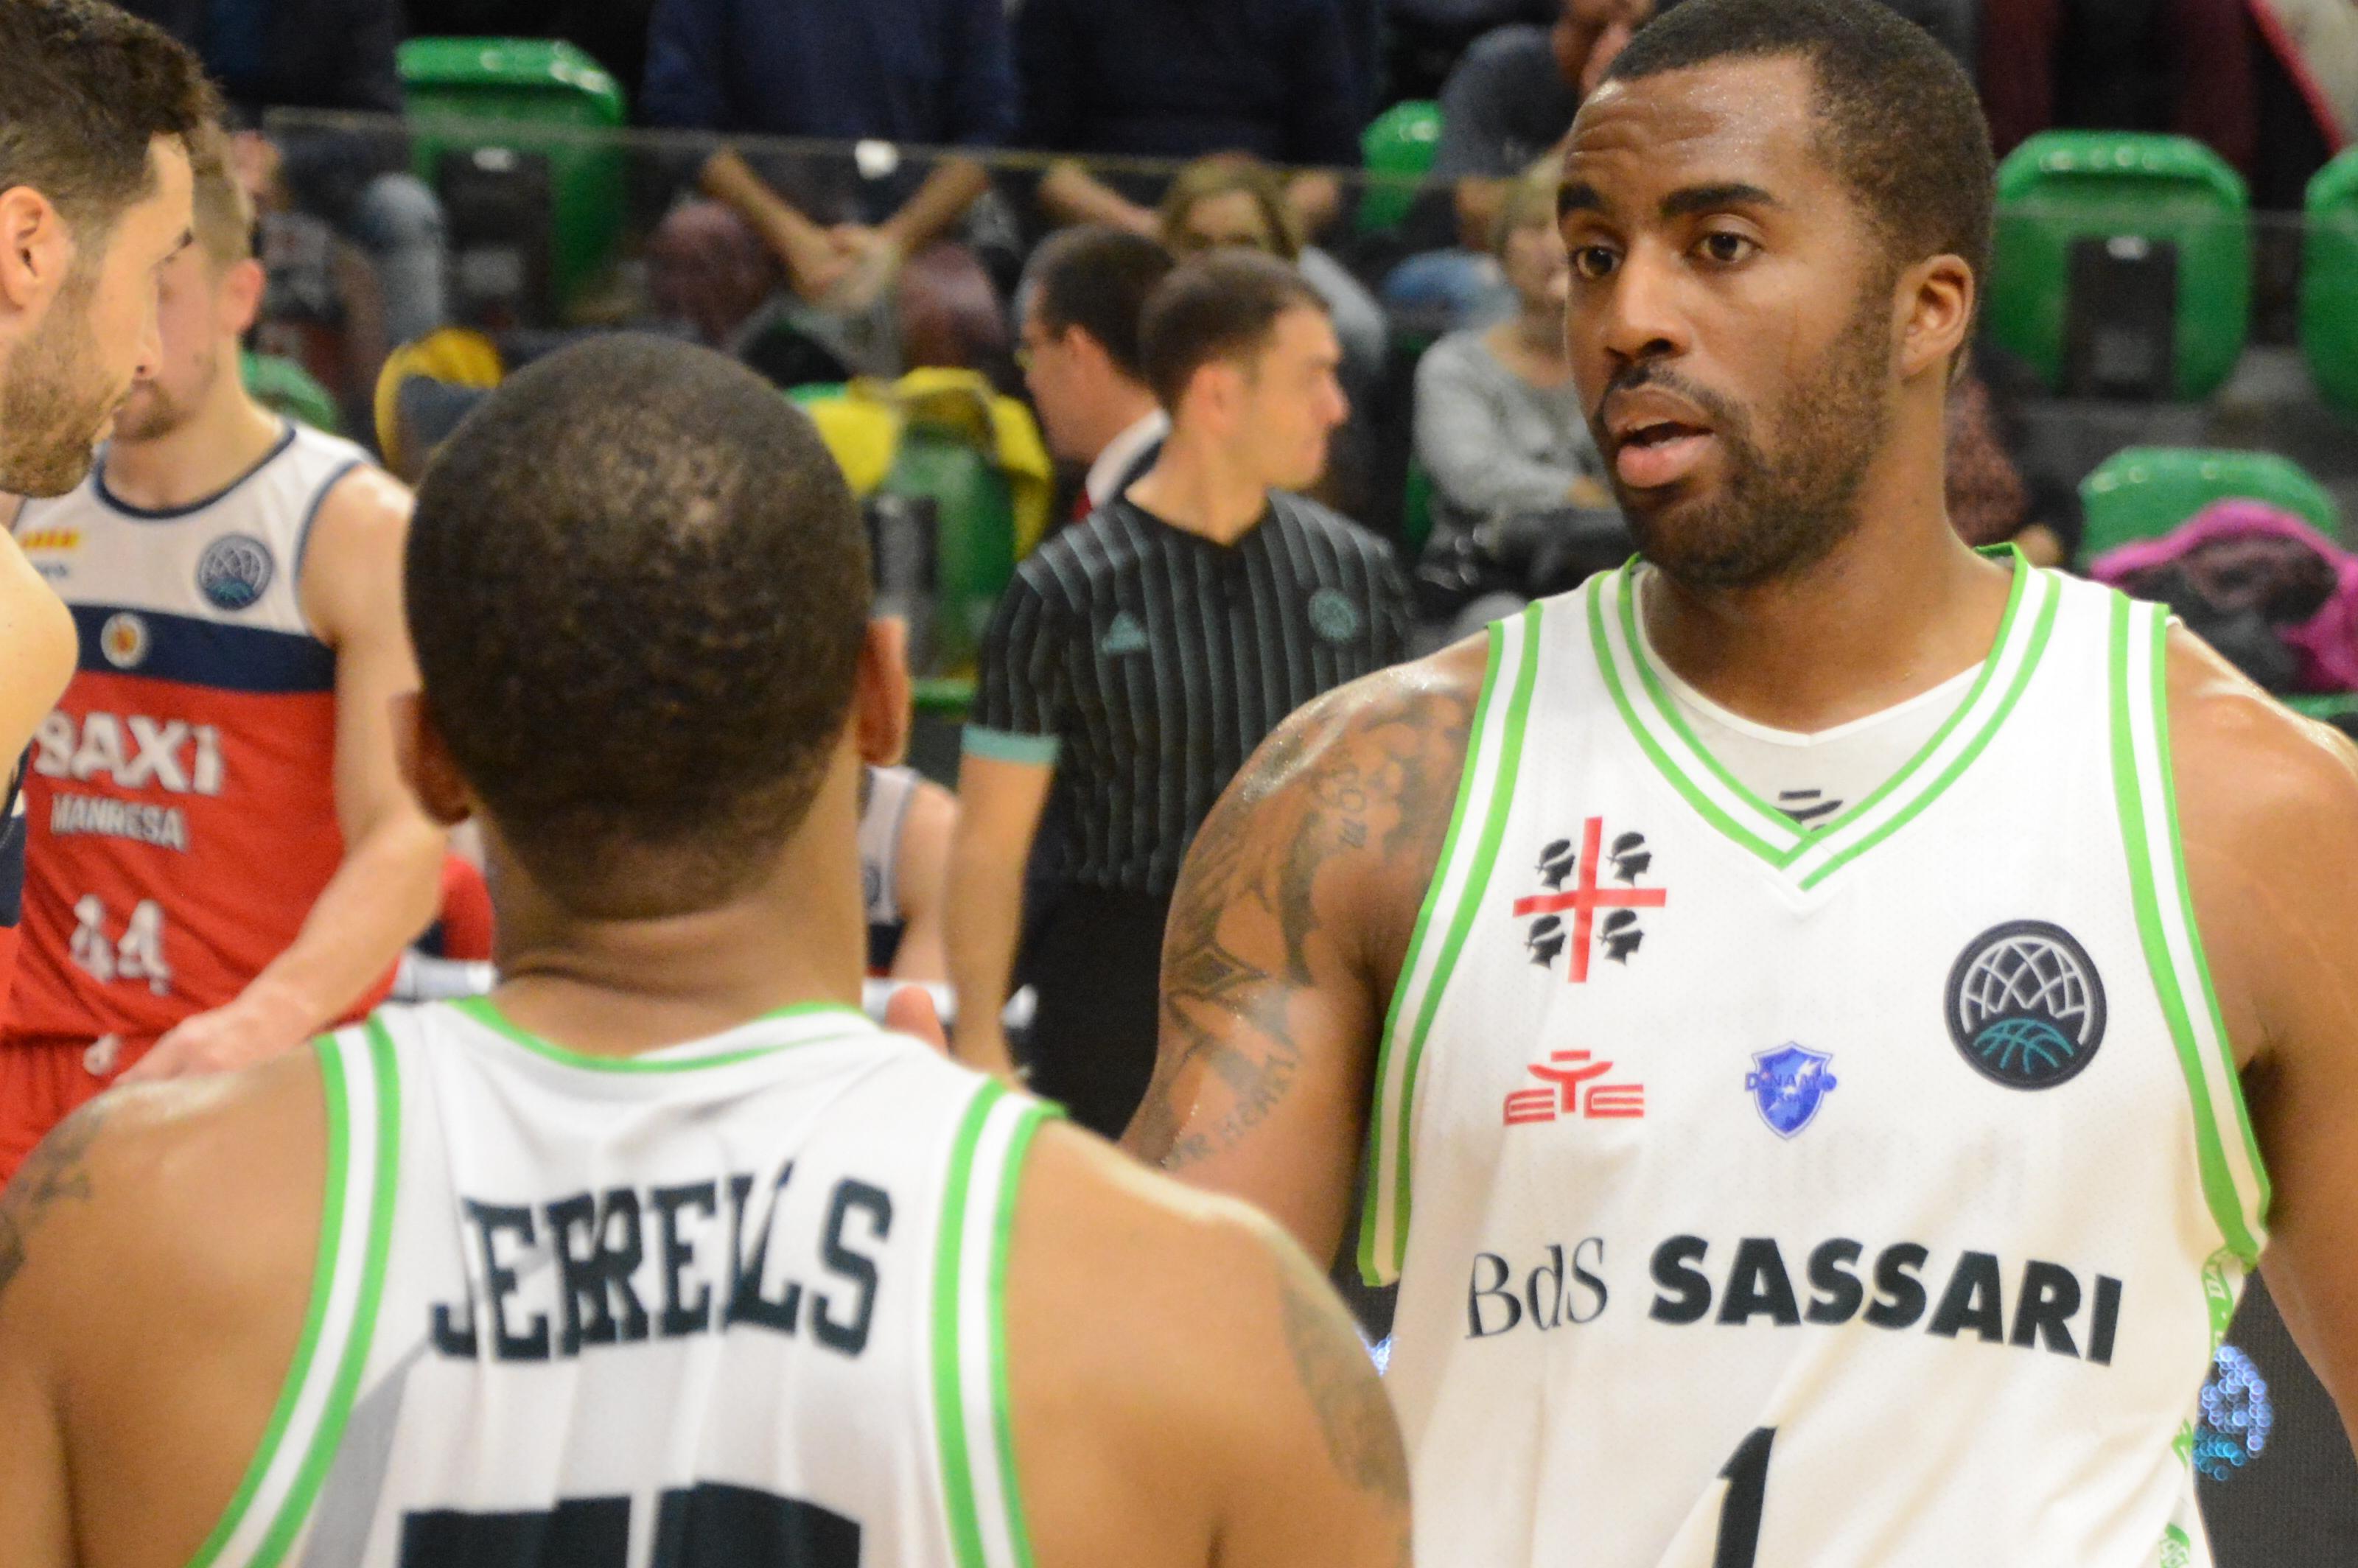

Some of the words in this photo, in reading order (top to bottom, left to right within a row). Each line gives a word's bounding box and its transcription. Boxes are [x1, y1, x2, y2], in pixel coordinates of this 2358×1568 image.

[50, 792, 189, 854] MANRESA
[1464, 1236, 1609, 1340] BdS
[1648, 1233, 2123, 1368] SASSARI
